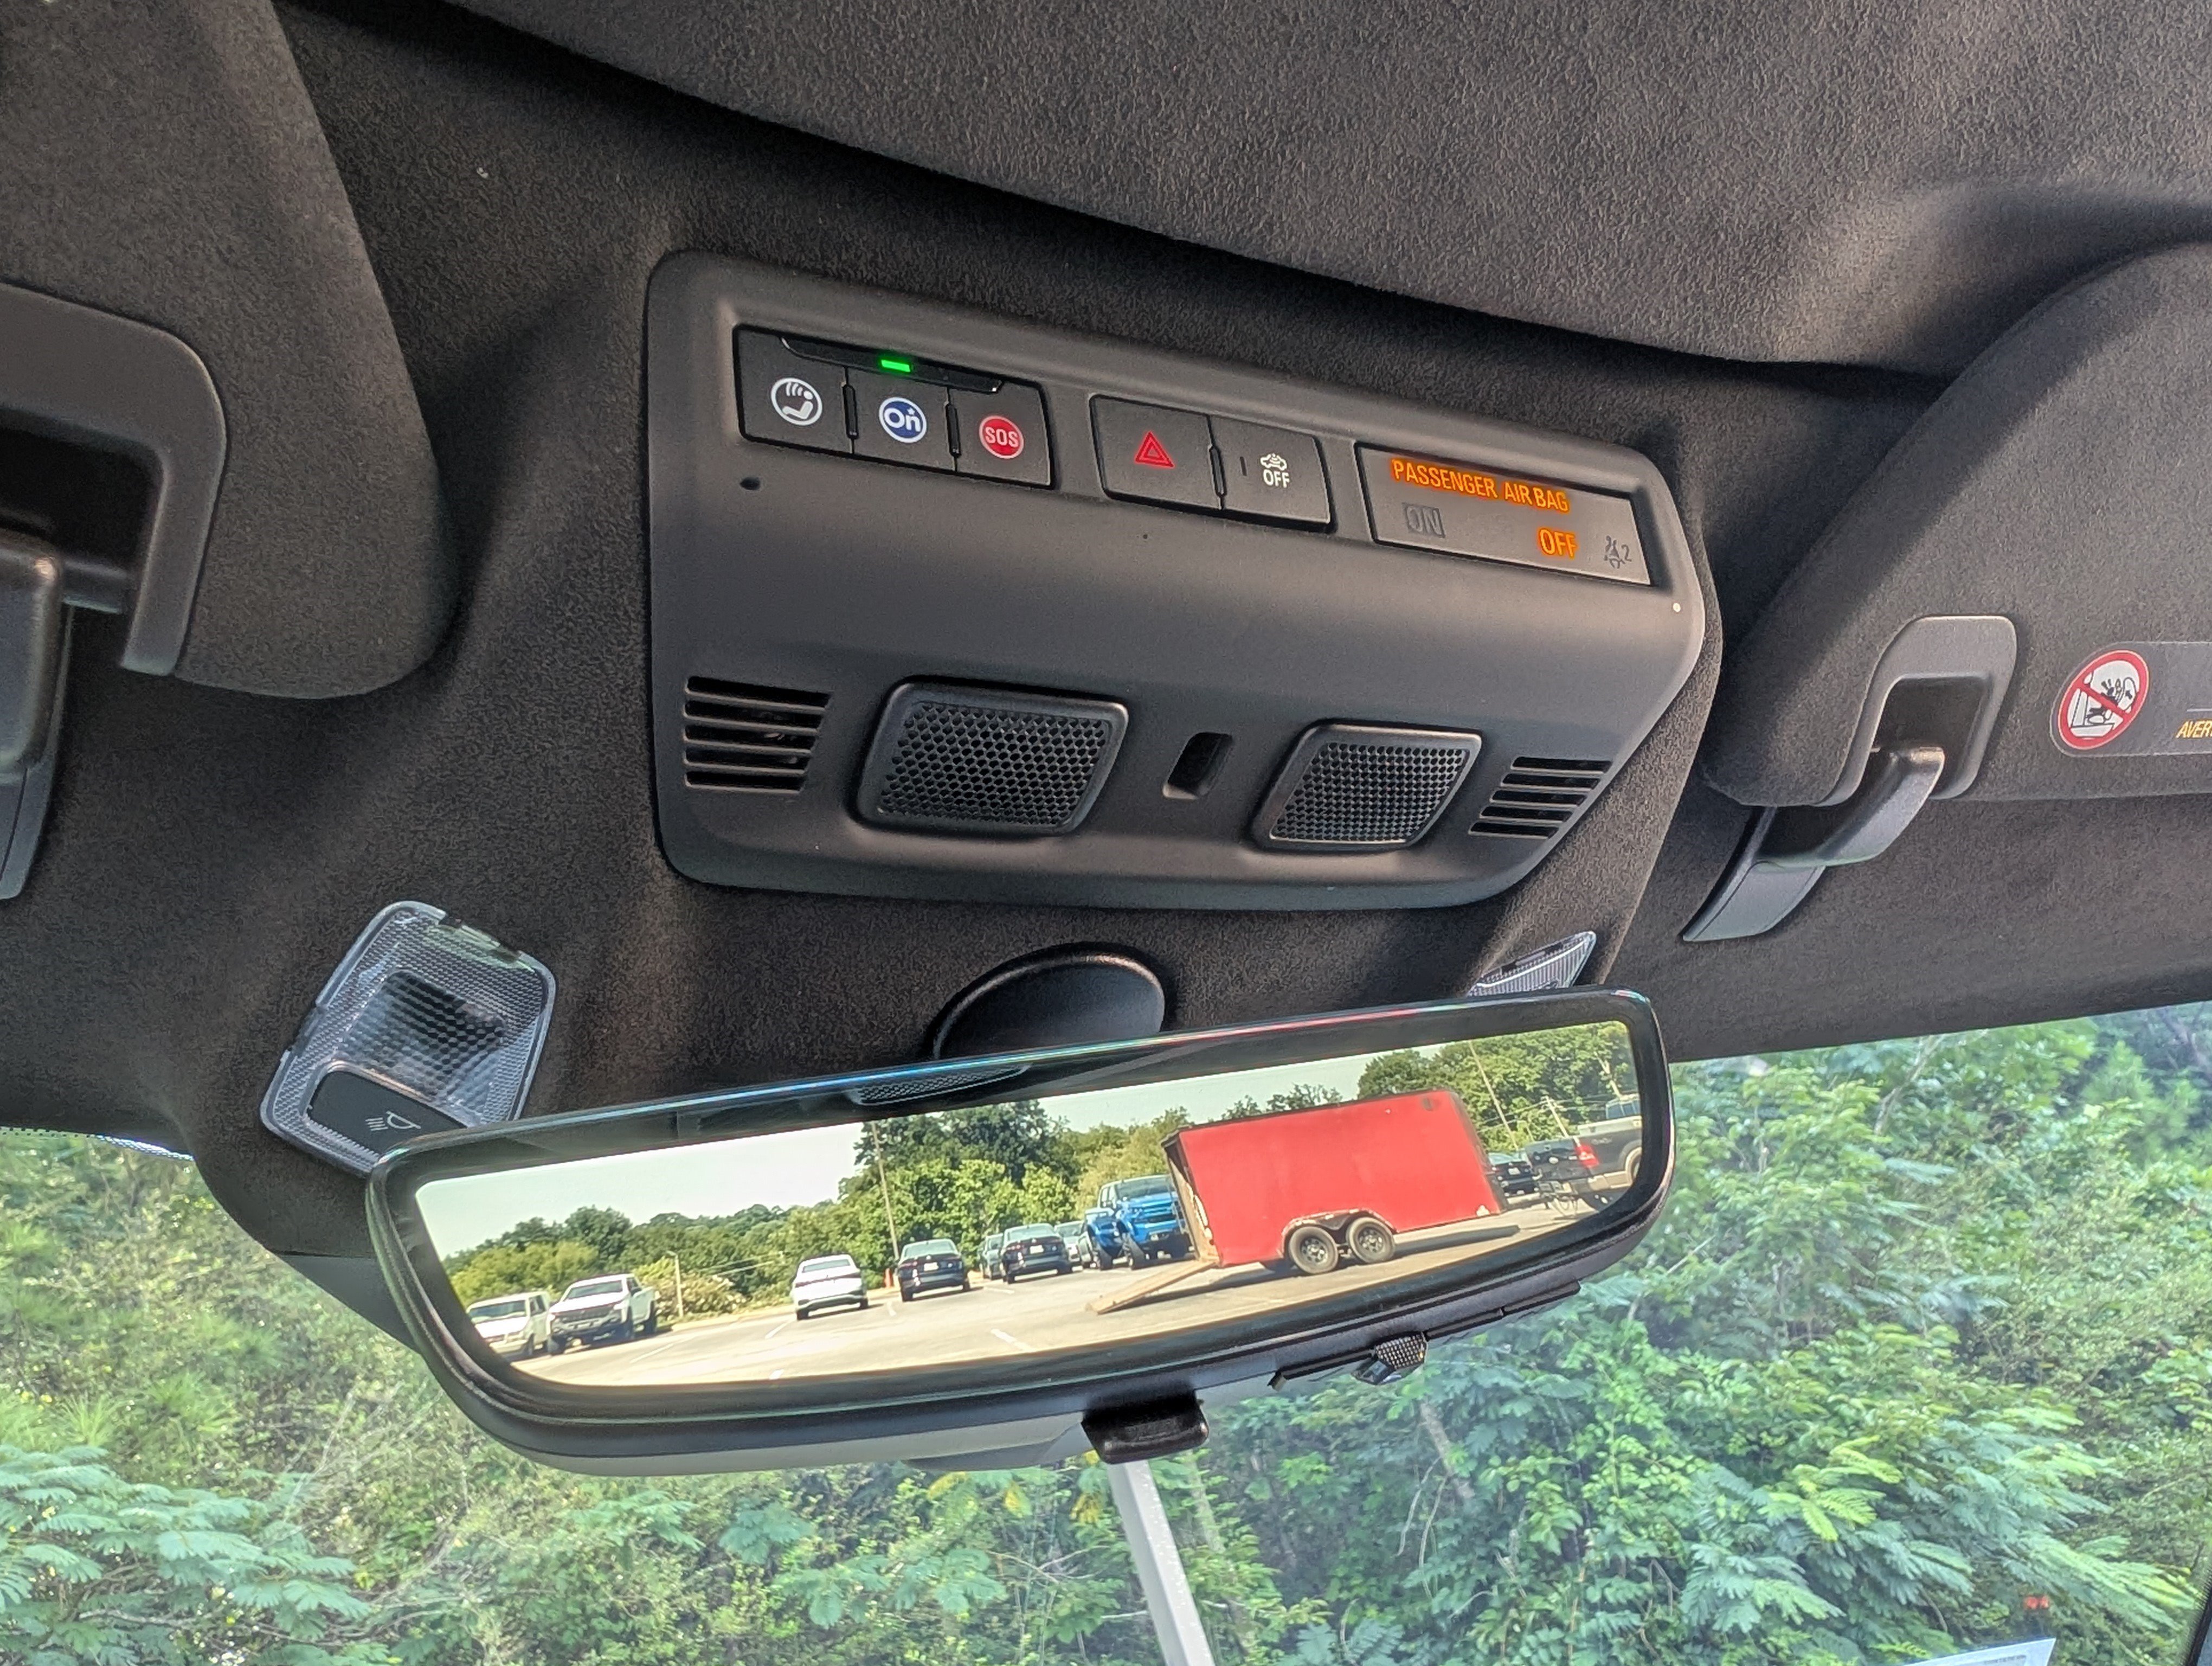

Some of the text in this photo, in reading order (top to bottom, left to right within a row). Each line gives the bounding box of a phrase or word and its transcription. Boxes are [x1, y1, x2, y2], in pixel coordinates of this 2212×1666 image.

[883, 406, 922, 432] On
[985, 426, 1019, 448] SOS
[1263, 469, 1290, 488] OFF
[1391, 459, 1498, 499] PASSENGER
[1405, 505, 1446, 538] ON
[1539, 529, 1578, 558] OFF
[2176, 720, 2212, 738] AVER
